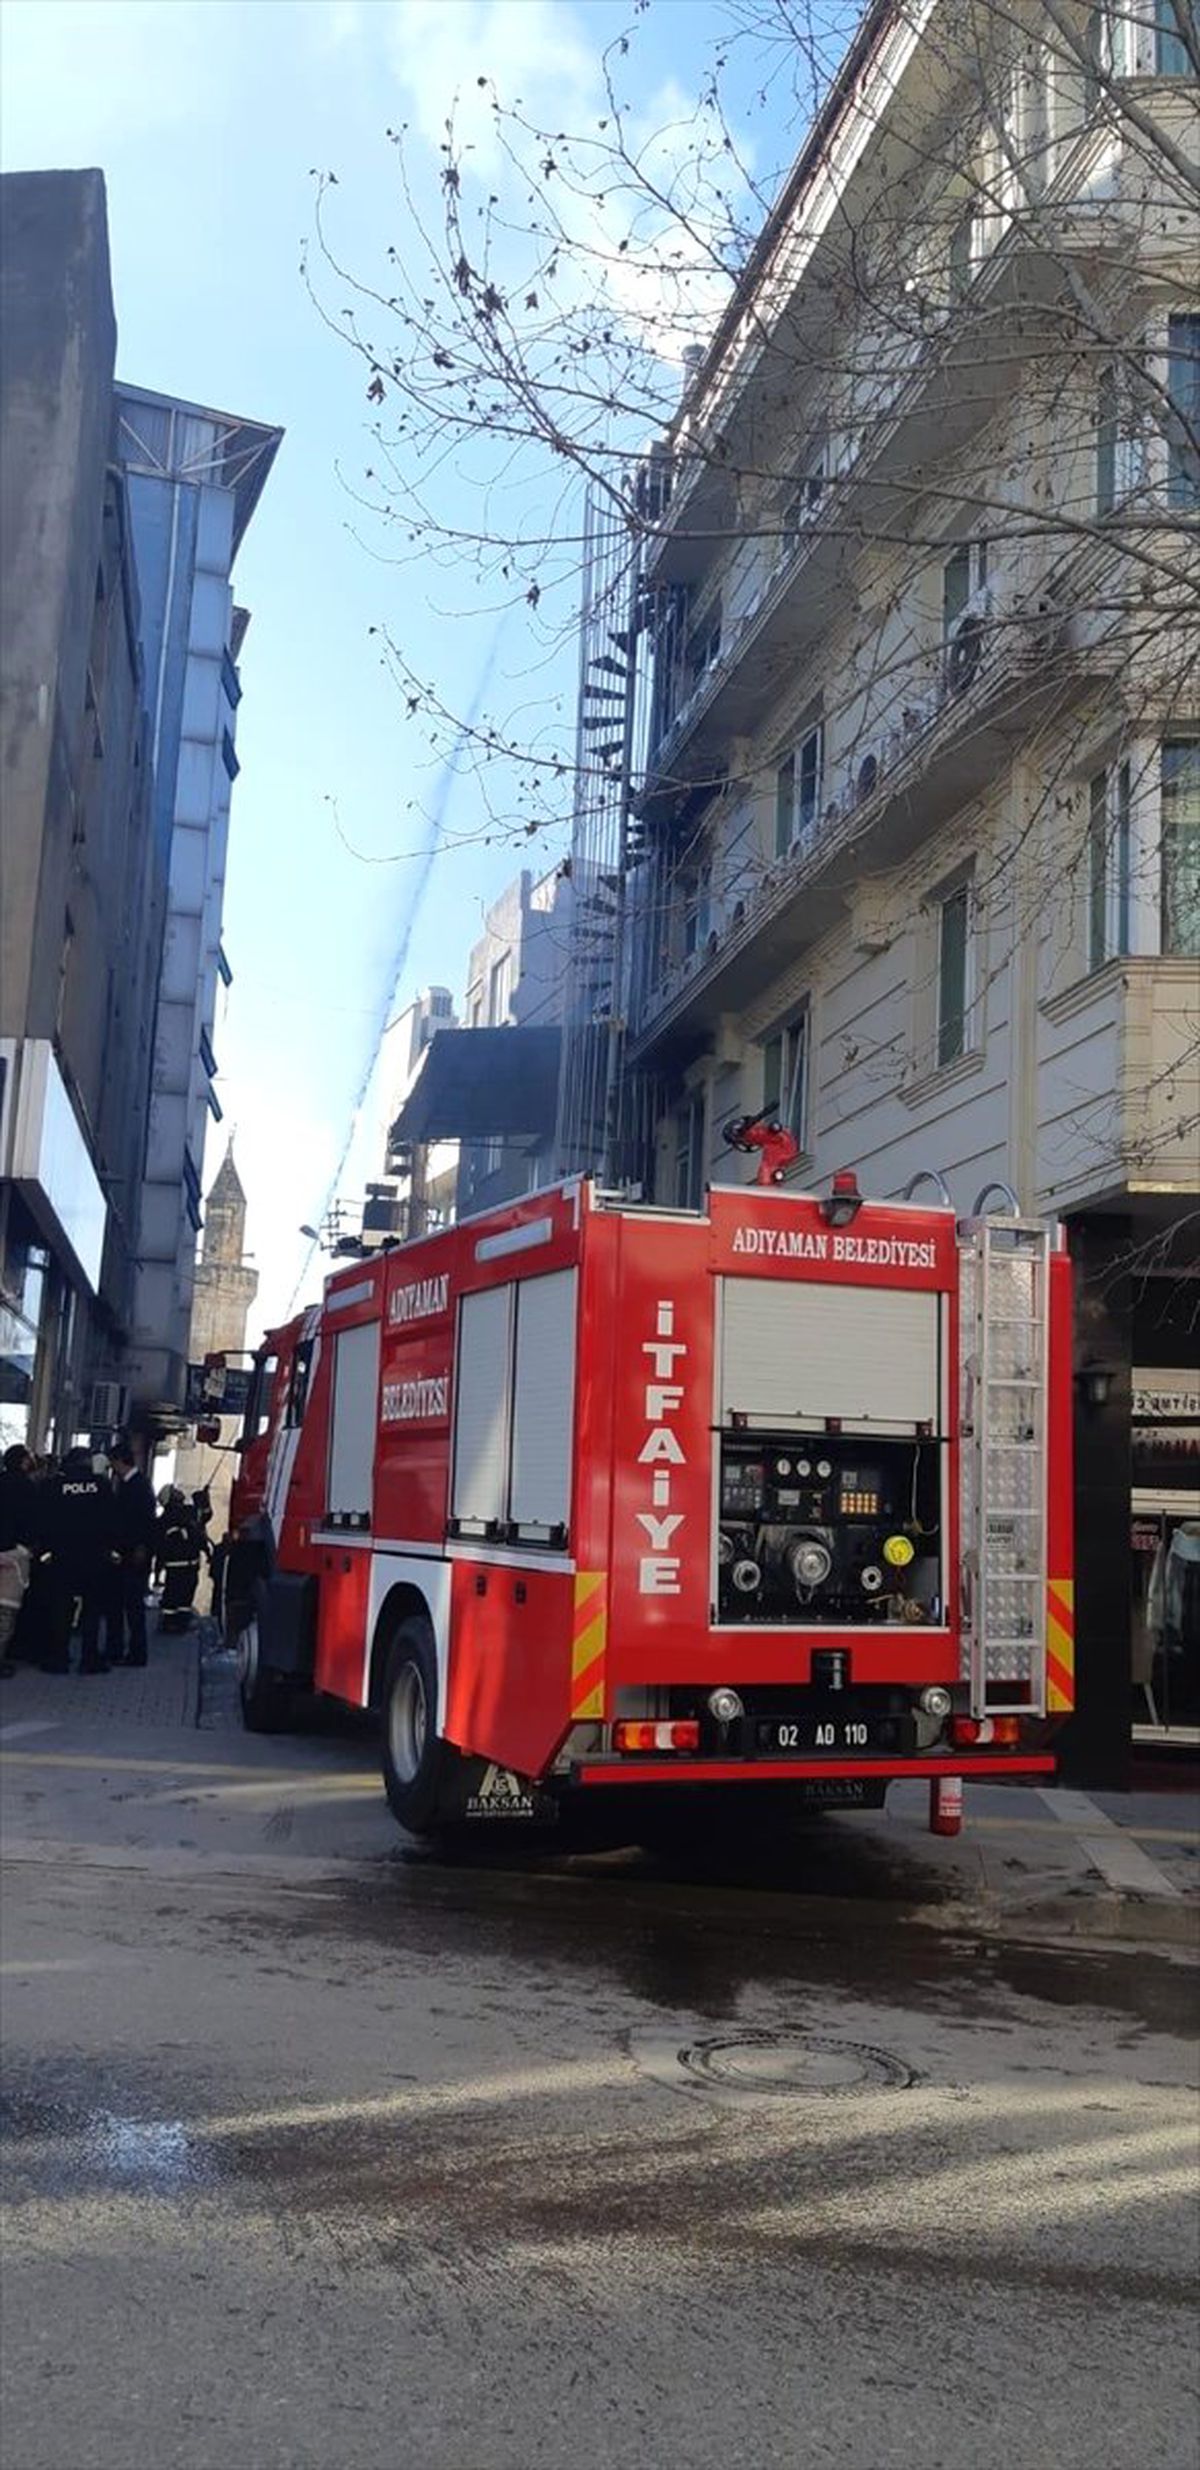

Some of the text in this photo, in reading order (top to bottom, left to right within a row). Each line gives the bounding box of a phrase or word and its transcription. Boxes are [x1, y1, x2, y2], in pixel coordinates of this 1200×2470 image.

[732, 1226, 937, 1268] ADIYAMAN BELEDİYESİ
[388, 1273, 449, 1327] ADIYAMAN
[381, 1368, 449, 1424] BELEDİYESİ
[635, 1300, 687, 1595] İTFAİYE
[779, 1724, 798, 1746] 02
[845, 1722, 868, 1745] 110
